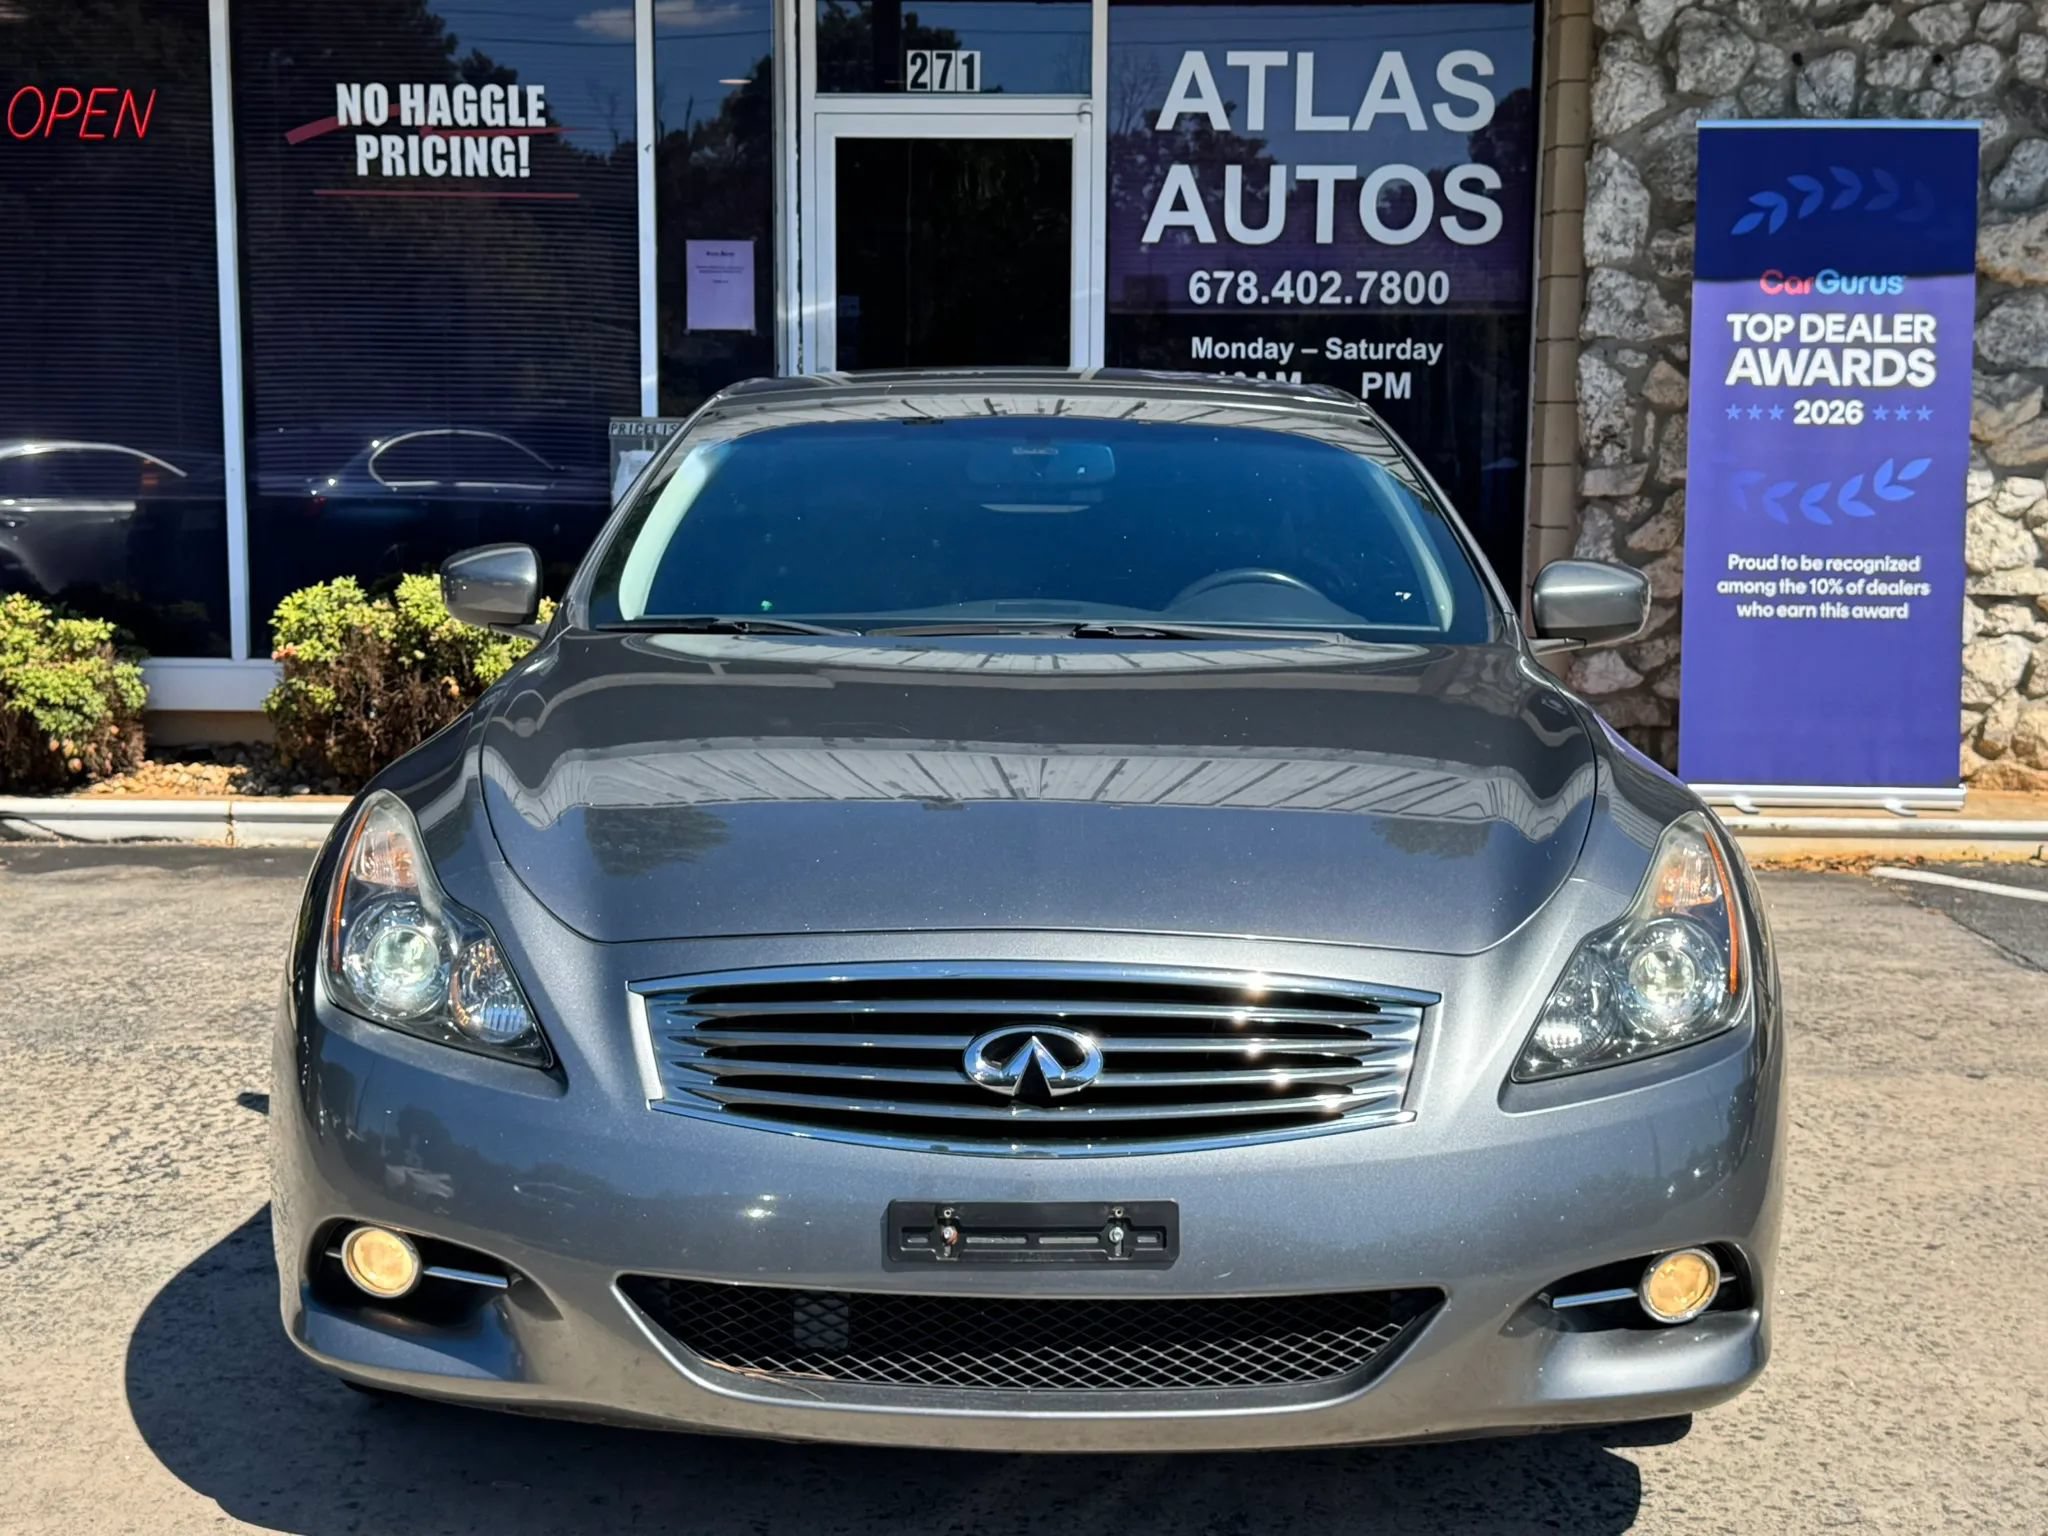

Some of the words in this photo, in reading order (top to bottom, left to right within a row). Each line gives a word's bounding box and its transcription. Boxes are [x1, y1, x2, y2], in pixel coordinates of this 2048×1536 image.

[909, 51, 975, 90] 271
[336, 82, 389, 127] NO
[399, 83, 547, 127] HAGGLE
[1155, 49, 1495, 132] ATLAS
[7, 85, 156, 139] OPEN
[355, 134, 531, 178] PRICING!
[1141, 163, 1504, 246] AUTOS
[1188, 270, 1450, 306] 678.402.7800
[1759, 269, 1905, 295] CarGurus
[1726, 313, 1795, 343] TOP
[1800, 313, 1937, 344] DEALER
[1191, 336, 1295, 365] Monday
[1325, 337, 1444, 366] Saturday
[1724, 348, 1937, 388] AWARDS
[1360, 371, 1412, 400] PM
[1793, 399, 1864, 425] 2026
[1728, 554, 1779, 571] Proud
[1781, 555, 1798, 571] to
[1801, 555, 1823, 571] be
[1826, 555, 1921, 575] recognized
[1717, 579, 1777, 597] among
[1779, 578, 1807, 595] the
[1810, 578, 1843, 596] 10%
[1846, 578, 1865, 596] of
[1866, 579, 1931, 596] dealers
[1737, 601, 1774, 618] who
[1777, 603, 1817, 619] earn
[1820, 602, 1849, 619] this
[1852, 602, 1909, 619] award
